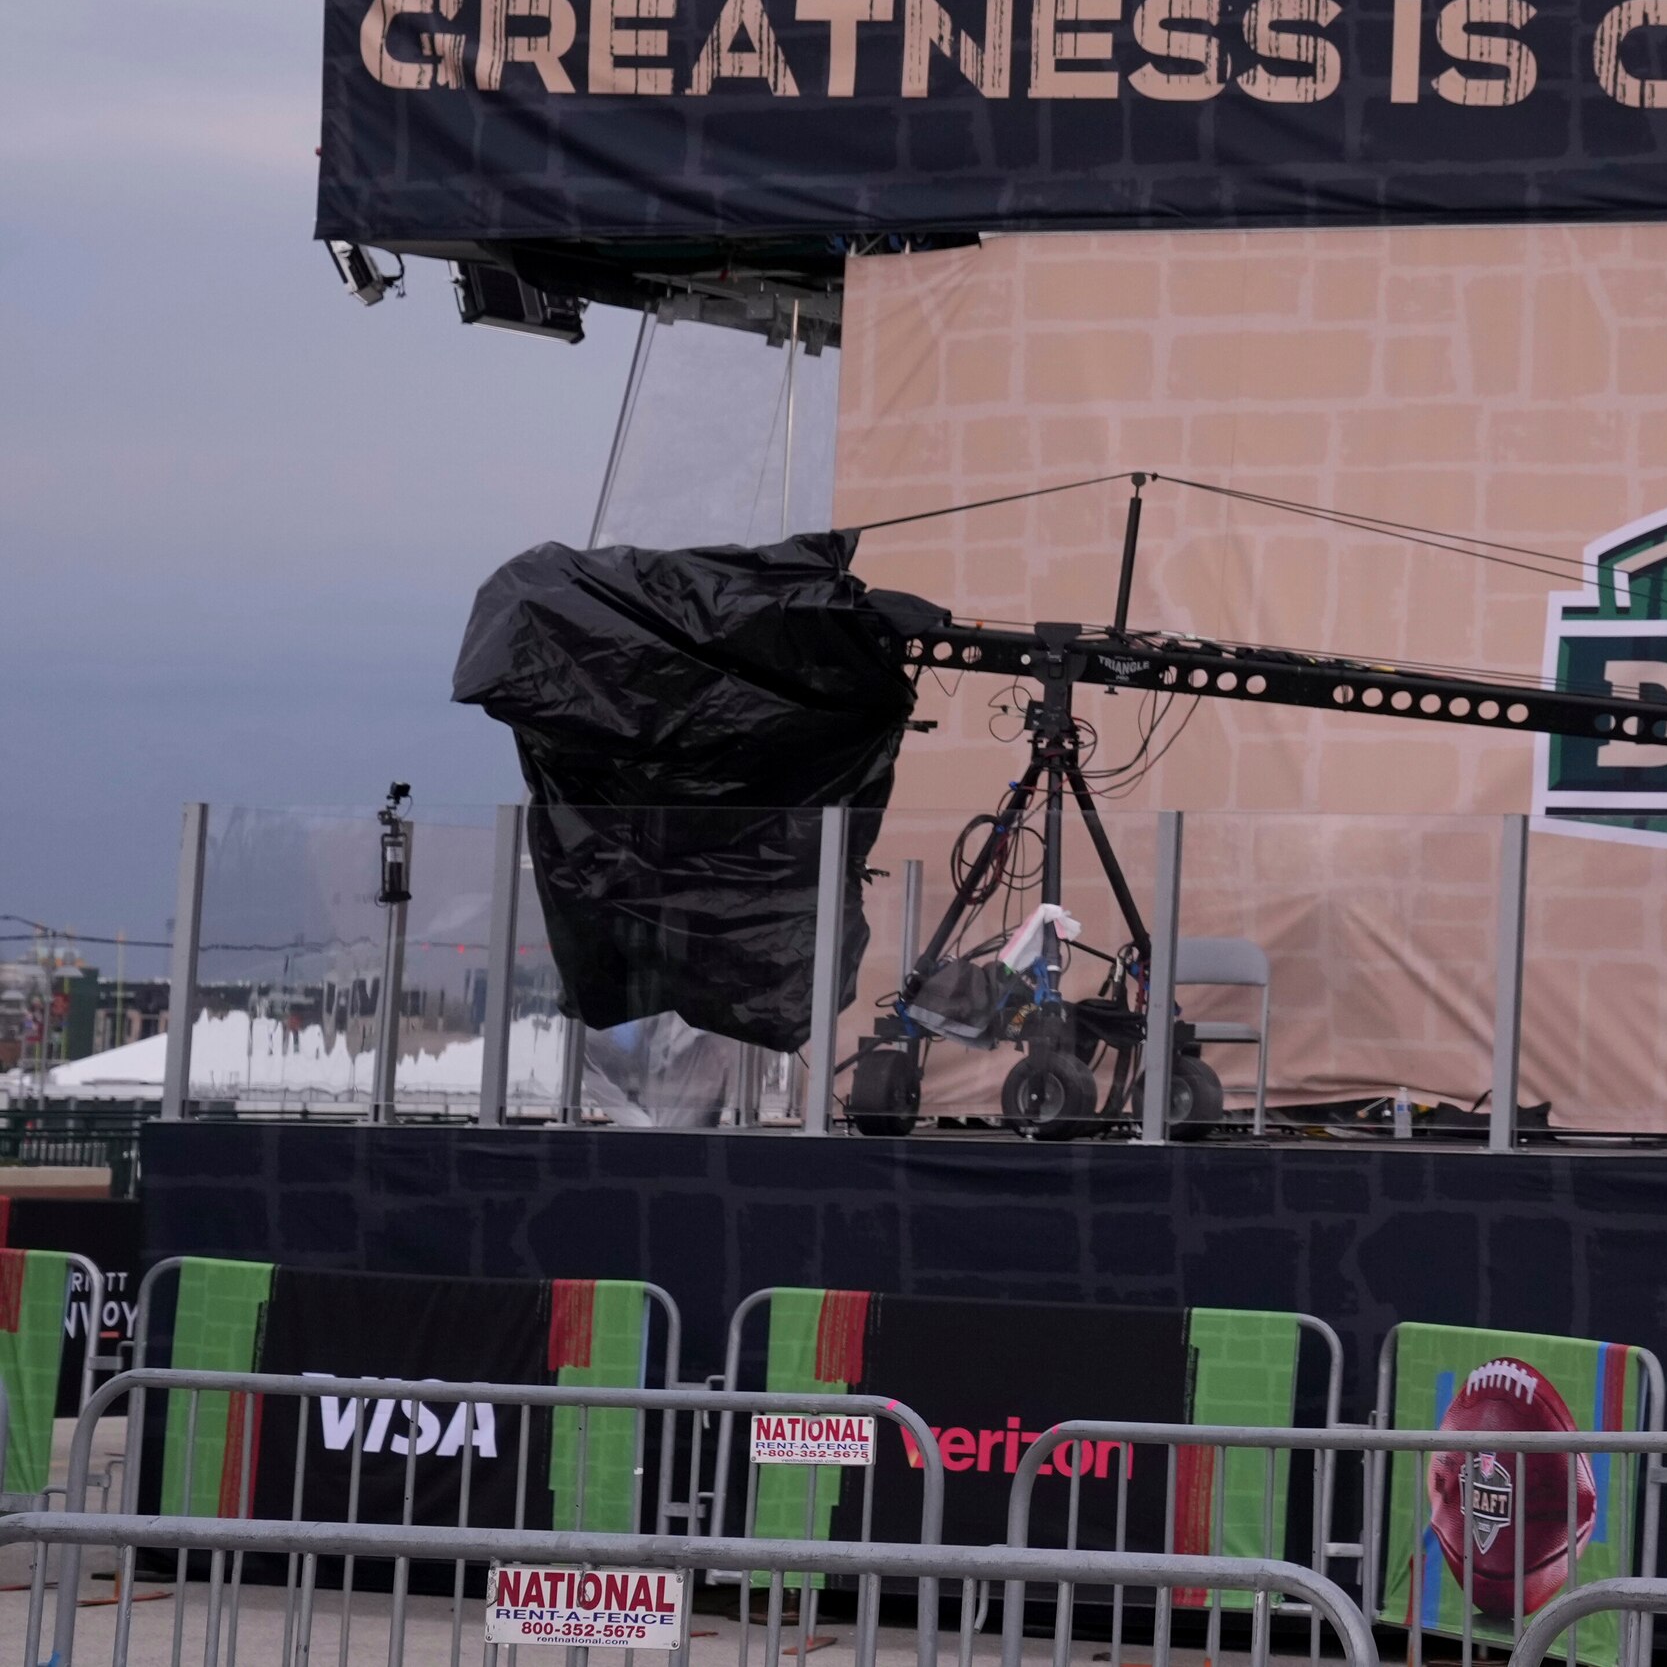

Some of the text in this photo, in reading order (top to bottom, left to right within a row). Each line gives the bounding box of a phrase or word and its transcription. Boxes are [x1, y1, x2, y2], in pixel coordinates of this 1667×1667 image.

[301, 1371, 498, 1458] VISA
[756, 1417, 870, 1442] NATIONAL
[755, 1442, 870, 1451] RENT-A-FENCE
[755, 1450, 869, 1458] 1-800-352-5675
[900, 1416, 1134, 1480] verizon
[496, 1570, 676, 1613] NATIONAL
[495, 1609, 675, 1625] RENT-A-FENCE
[521, 1621, 646, 1639] 800-352-5675
[536, 1636, 629, 1646] rentnational.com
